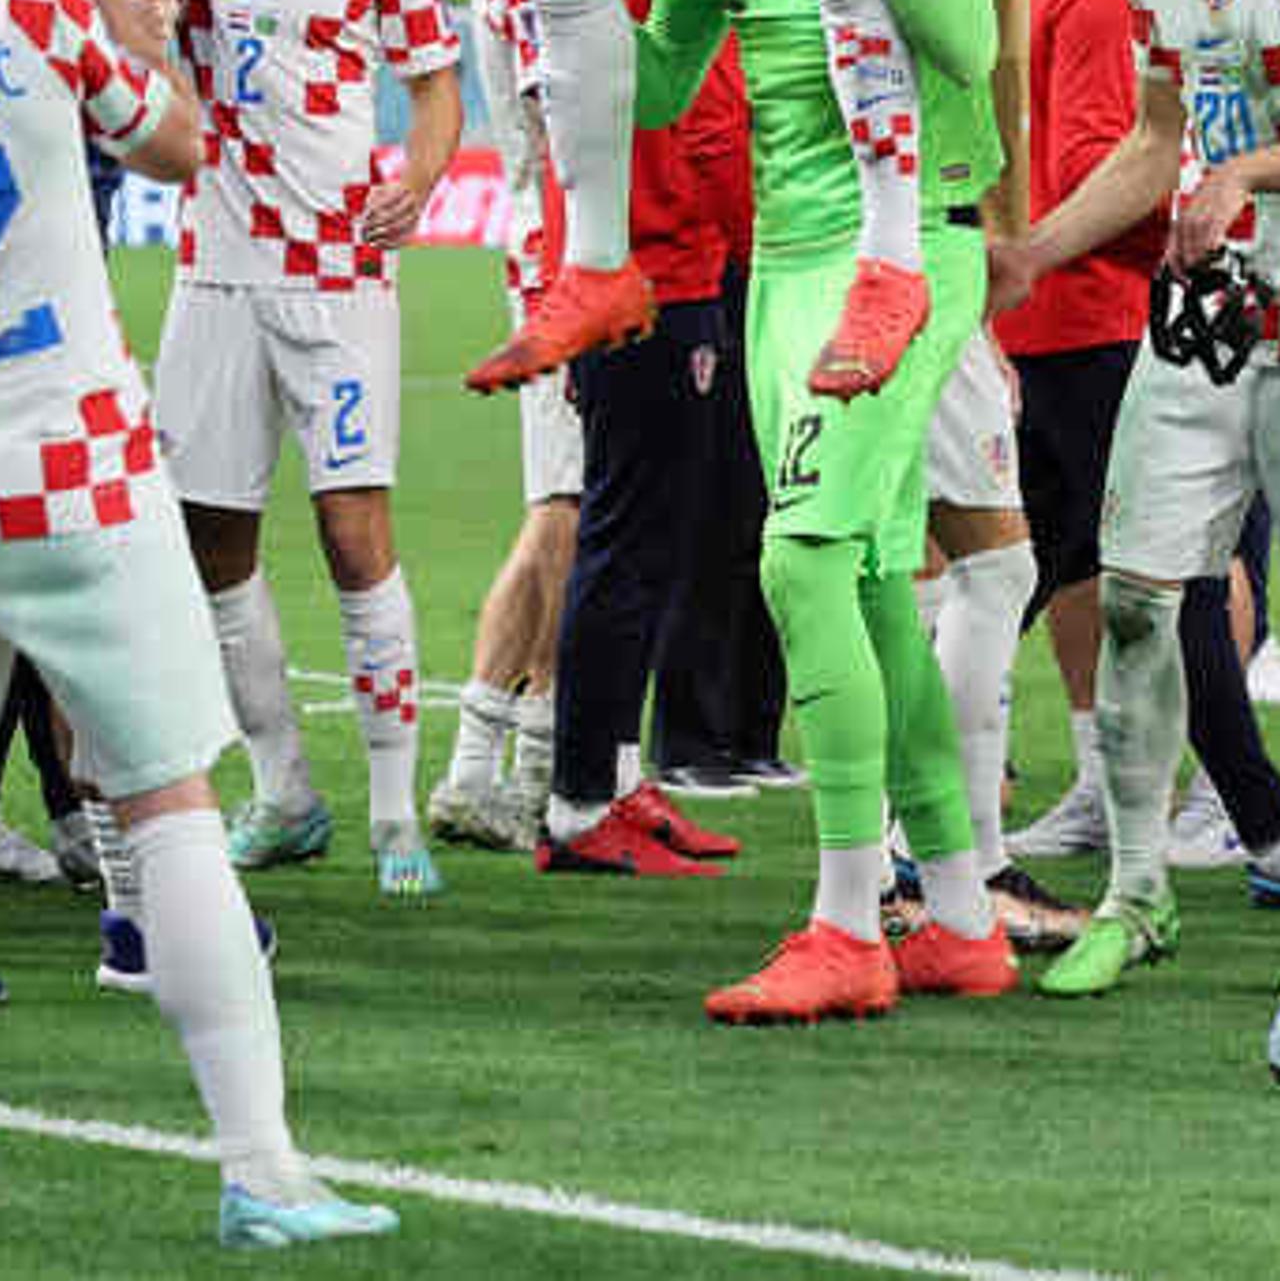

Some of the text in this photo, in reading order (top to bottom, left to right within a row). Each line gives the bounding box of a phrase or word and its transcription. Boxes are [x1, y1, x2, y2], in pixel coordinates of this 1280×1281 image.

[236, 39, 265, 102] 2
[1193, 91, 1258, 164] 20
[332, 379, 366, 447] 2
[778, 412, 822, 489] 12
